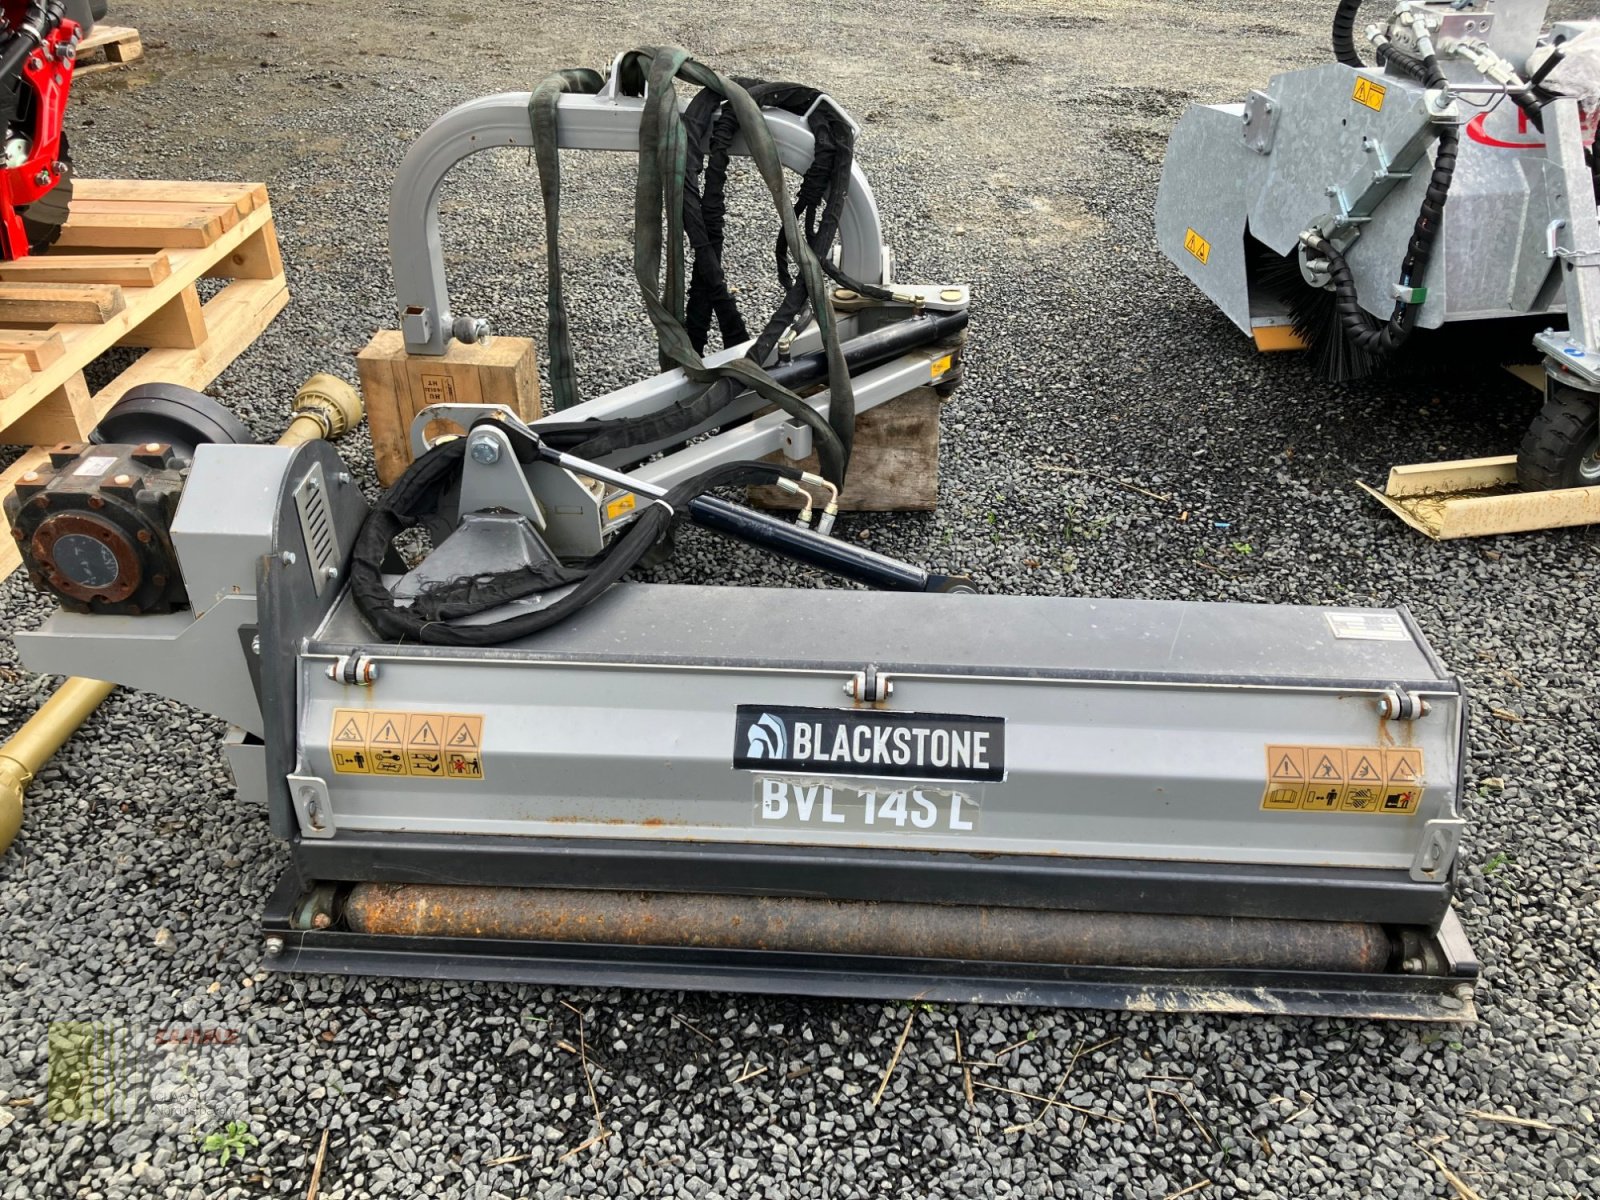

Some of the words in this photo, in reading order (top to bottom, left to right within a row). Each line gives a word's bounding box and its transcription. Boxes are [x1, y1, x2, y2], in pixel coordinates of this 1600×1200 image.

[793, 722, 990, 769] BLACKSTONE
[762, 778, 845, 824] BVL
[949, 795, 973, 831] L
